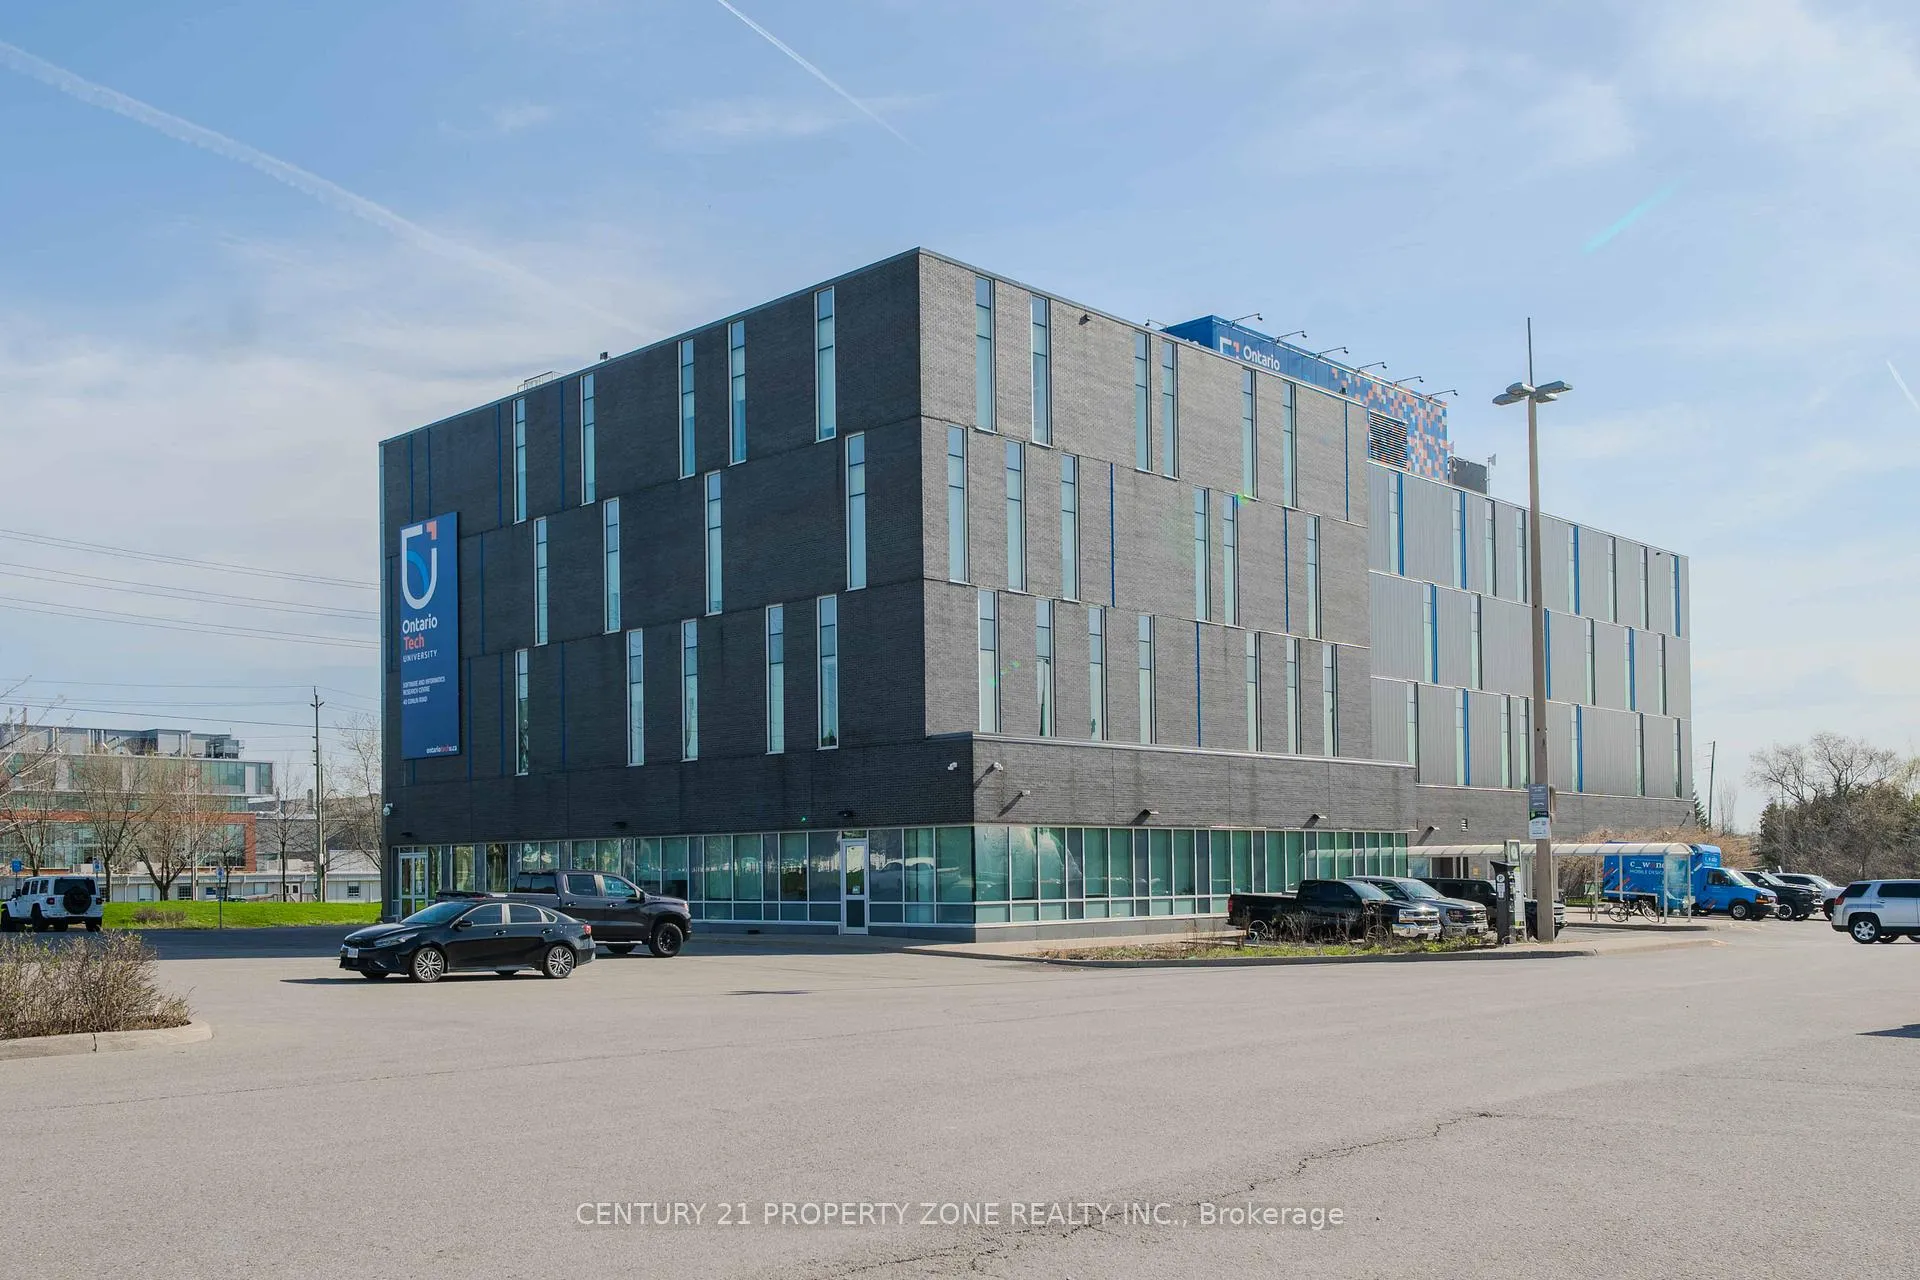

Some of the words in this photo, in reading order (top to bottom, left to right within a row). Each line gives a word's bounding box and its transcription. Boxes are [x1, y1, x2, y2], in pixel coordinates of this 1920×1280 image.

[1243, 344, 1280, 370] Ontario
[402, 613, 438, 634] Ontario
[403, 633, 425, 651] Tech
[402, 649, 438, 662] UNIVERSITY
